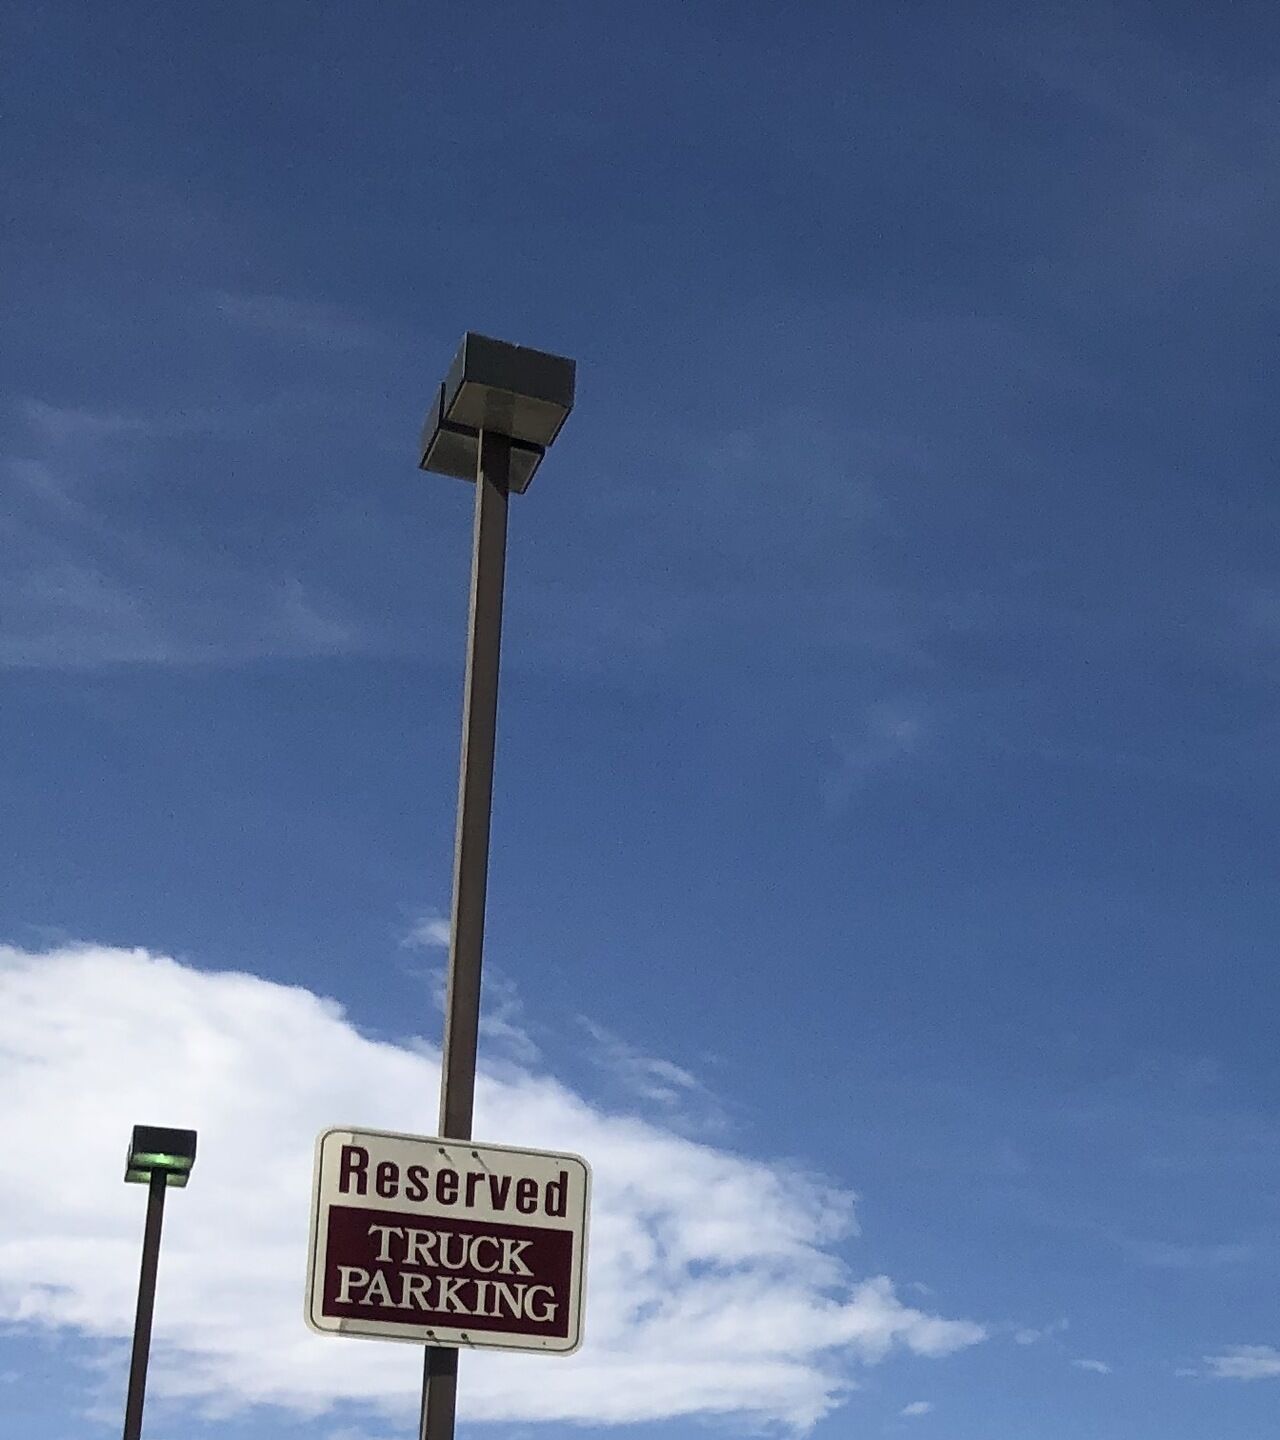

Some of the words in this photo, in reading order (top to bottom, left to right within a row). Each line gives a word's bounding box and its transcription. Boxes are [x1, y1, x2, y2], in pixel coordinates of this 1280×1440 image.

[338, 1144, 569, 1218] Reserved
[367, 1223, 535, 1277] TRUCK
[334, 1264, 559, 1323] PARKING
